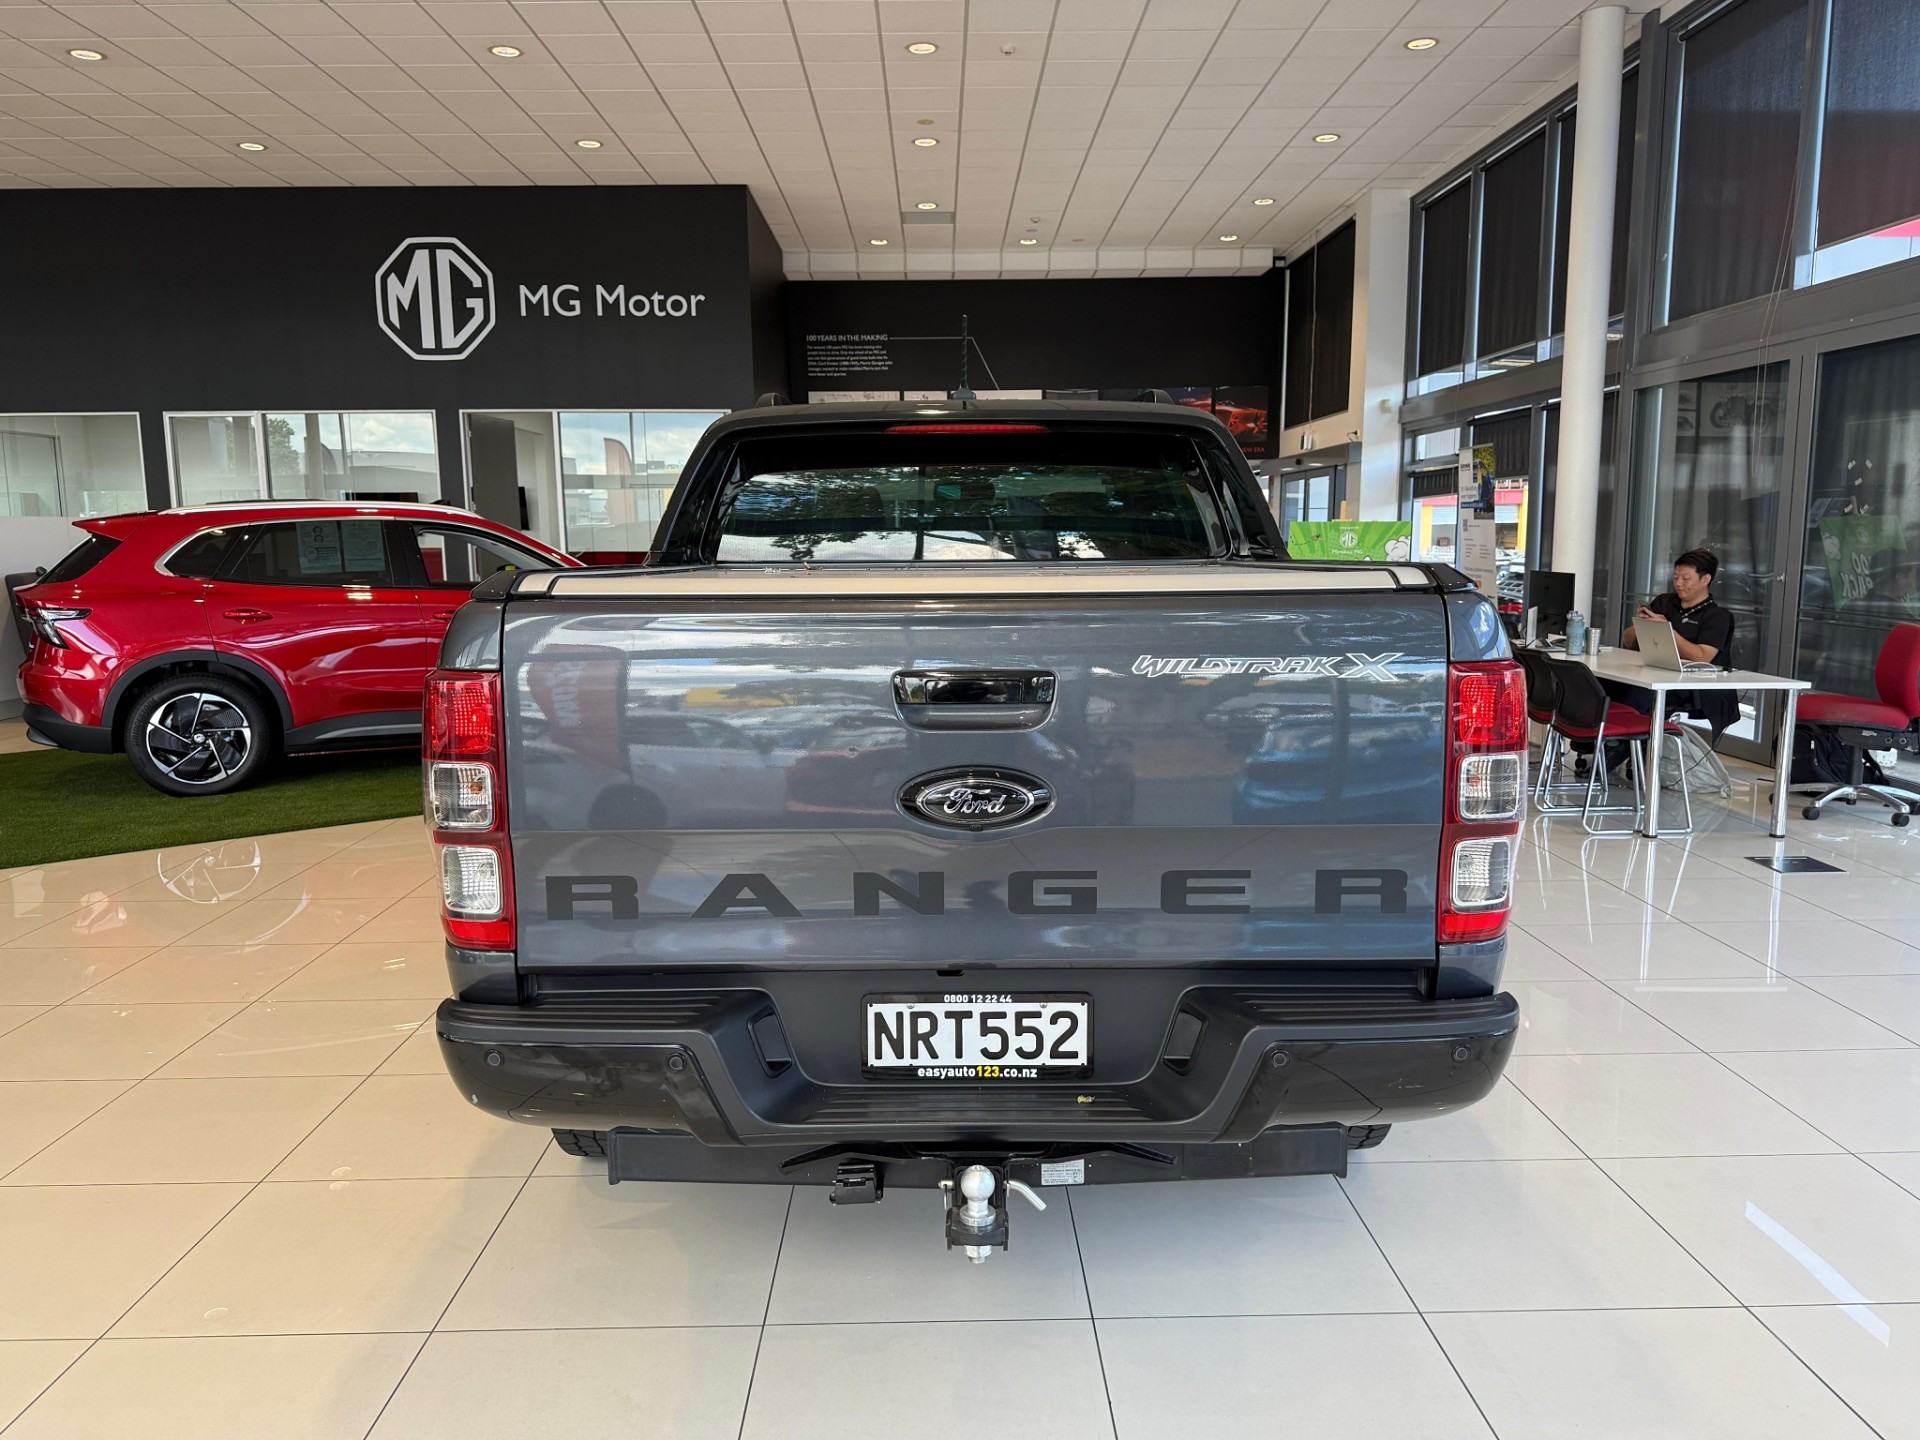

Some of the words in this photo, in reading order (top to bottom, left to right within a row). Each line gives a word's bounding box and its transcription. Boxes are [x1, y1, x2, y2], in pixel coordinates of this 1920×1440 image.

[386, 248, 484, 349] MG
[518, 284, 581, 317] MG
[595, 284, 706, 317] Motor
[1132, 655, 1343, 677] WILDTRAK
[1338, 652, 1404, 682] X
[943, 787, 1006, 814] Ford
[545, 868, 1409, 921] RANGER
[944, 994, 969, 1003] 0800
[971, 994, 983, 1003] 12
[985, 994, 998, 1003] 22
[999, 994, 1013, 1003] 44
[874, 1010, 1079, 1060] NRT552
[917, 1066, 1038, 1080] easyauto123.co.nz
